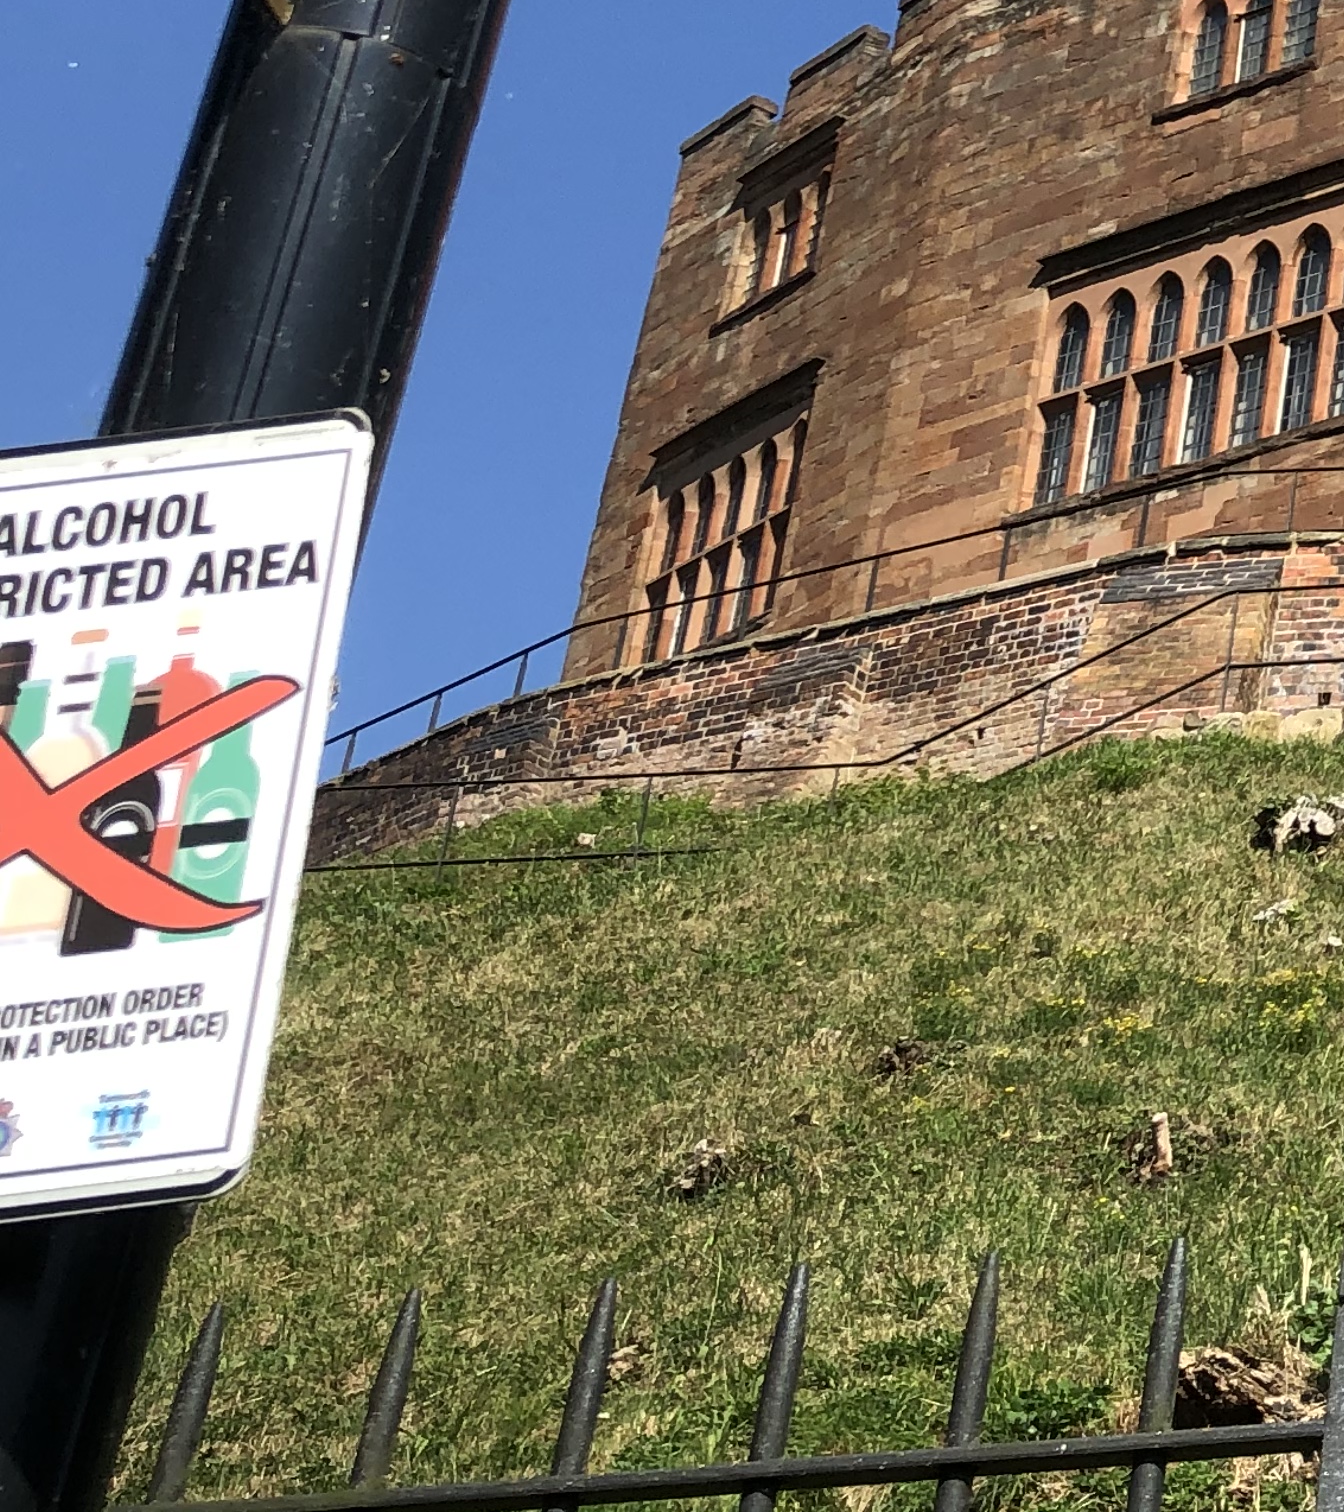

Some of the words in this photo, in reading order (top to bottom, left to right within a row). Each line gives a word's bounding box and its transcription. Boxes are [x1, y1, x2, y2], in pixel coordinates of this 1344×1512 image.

[0, 491, 216, 558] ALCOHOL
[181, 539, 321, 598] AREA
[0, 992, 117, 1030] OTECTION
[122, 982, 205, 1015] ORDER
[22, 1032, 41, 1059] A
[47, 1021, 137, 1056] PUBLIC
[142, 1010, 229, 1043] PLACE)
